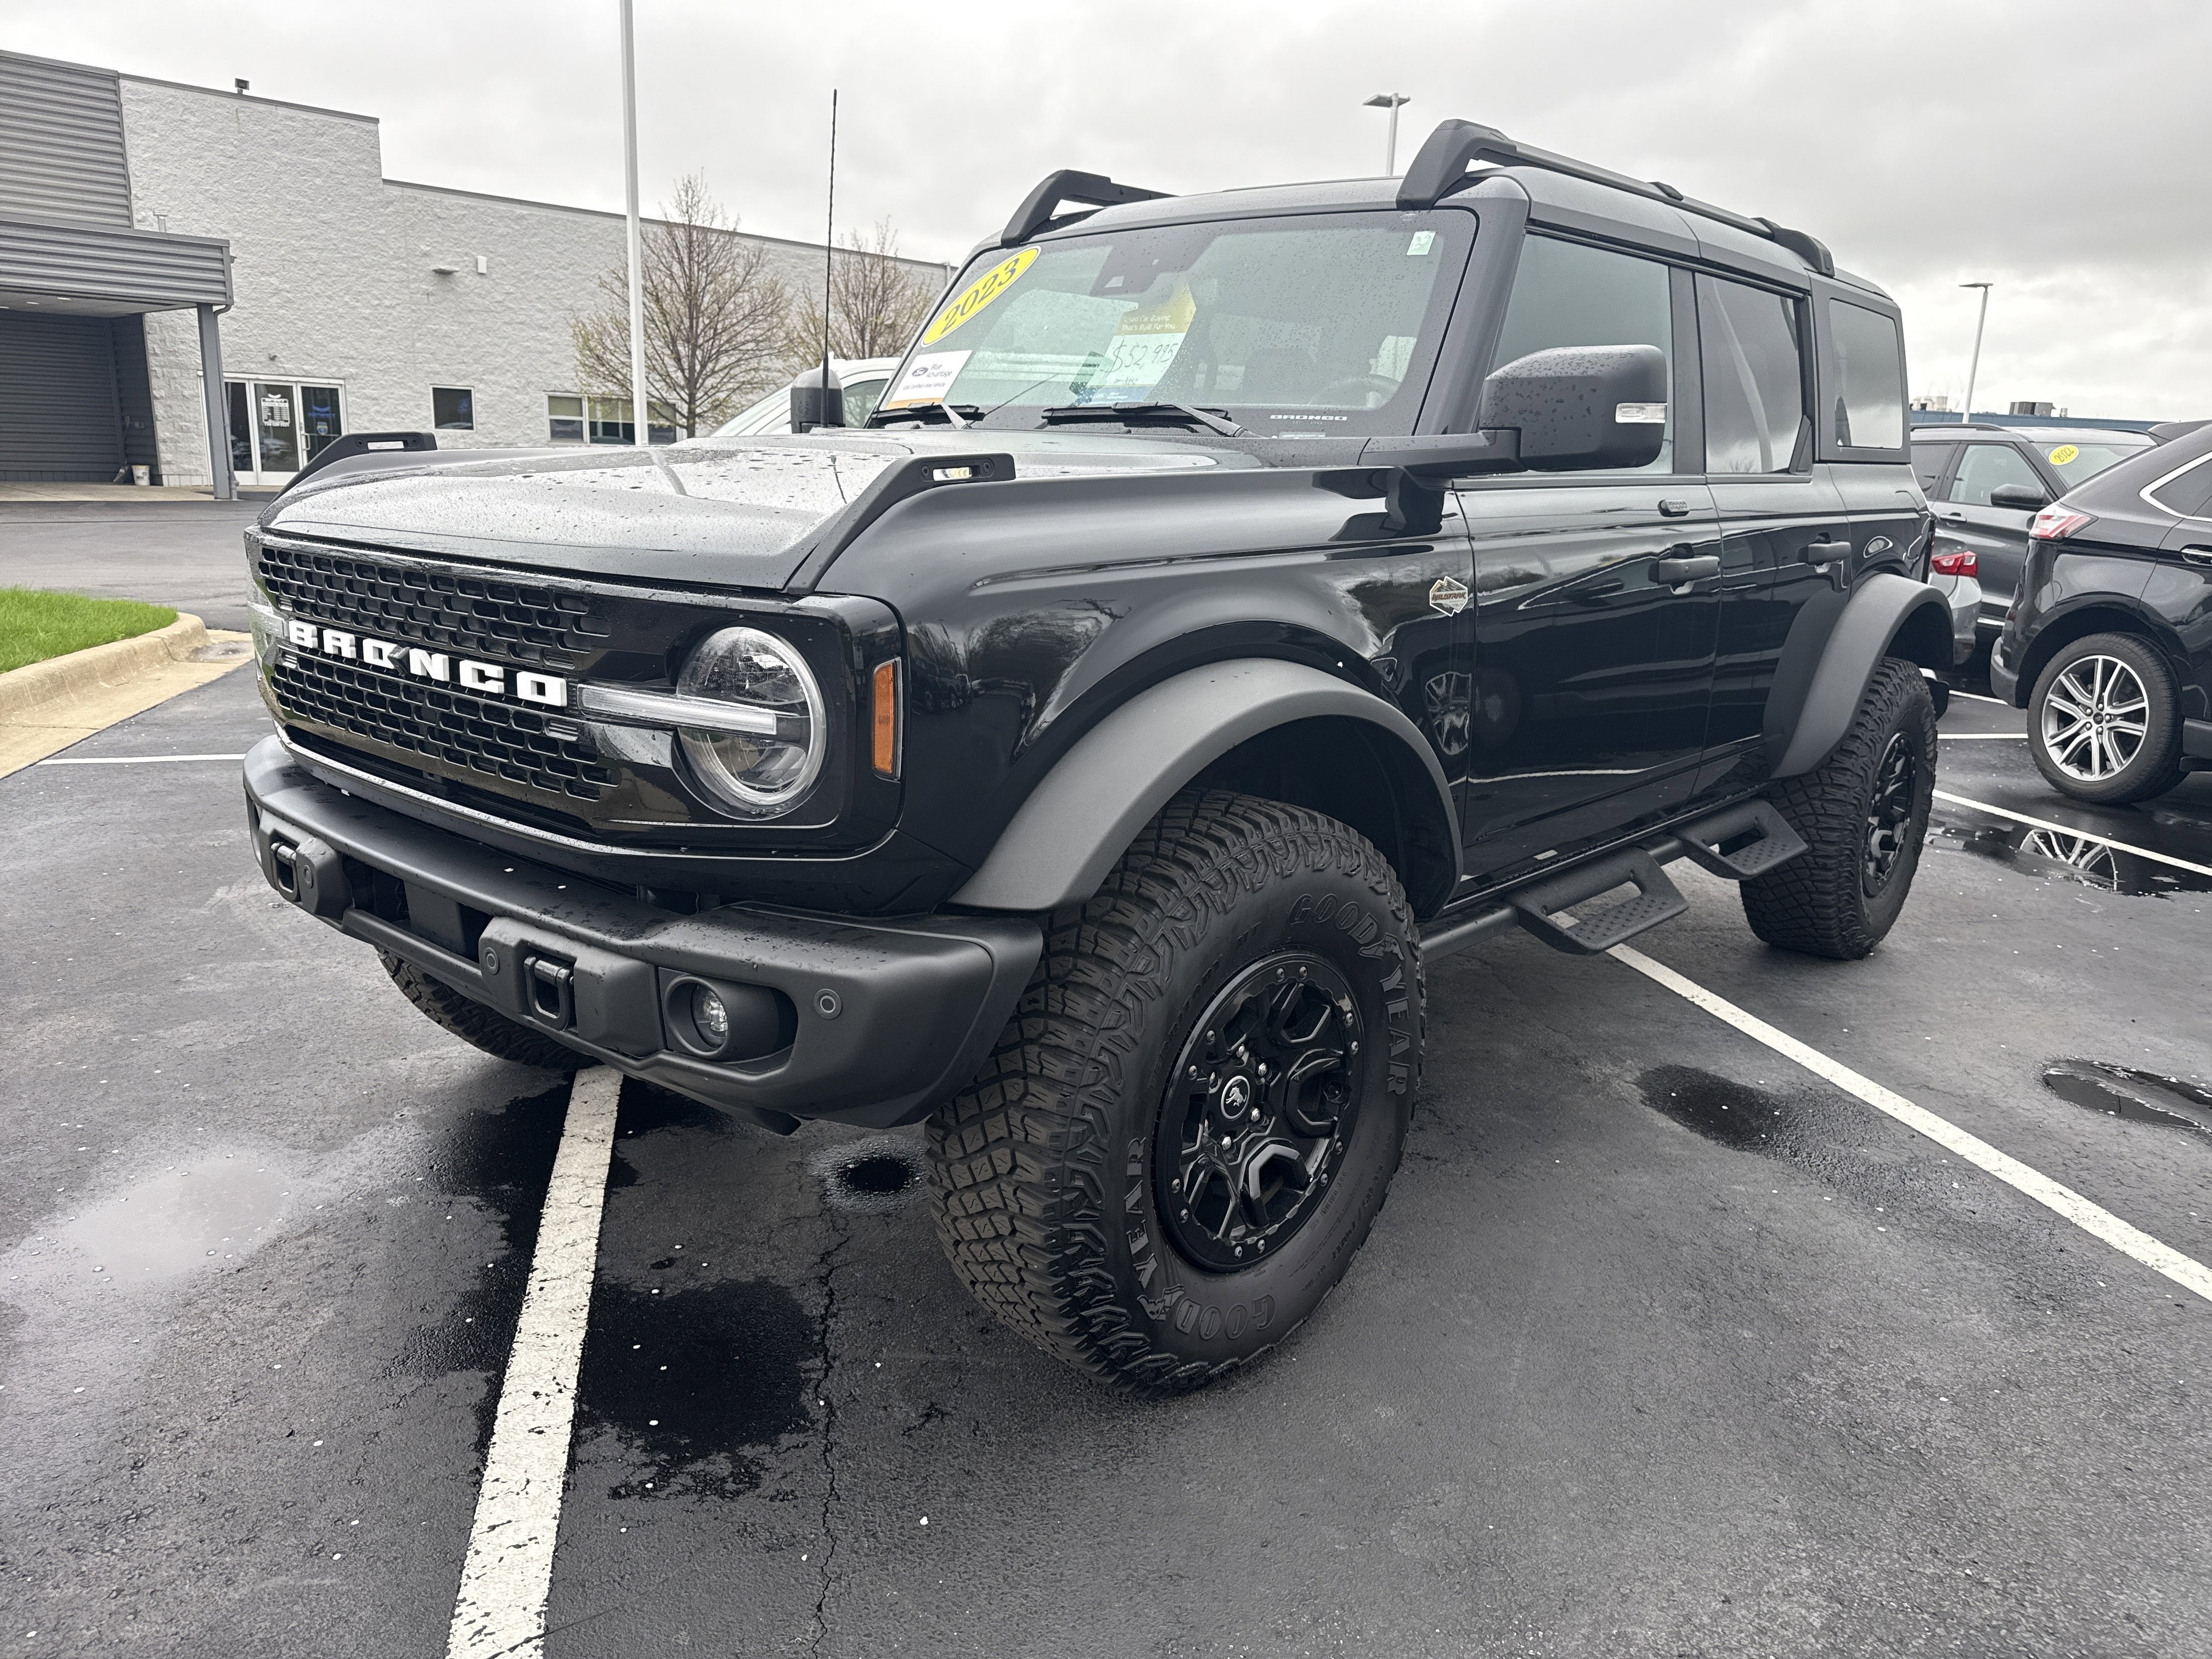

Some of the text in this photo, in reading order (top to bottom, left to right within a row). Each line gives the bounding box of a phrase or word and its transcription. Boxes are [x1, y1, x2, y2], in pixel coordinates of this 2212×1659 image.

[940, 258, 1020, 336] 2023
[2053, 447, 2075, 462] 2022
[1431, 592, 1466, 602] WILDTRAK
[289, 620, 567, 707] BRONCO
[1287, 893, 1412, 1095] GOODYEAR
[1124, 1136, 1277, 1340] GOODYEAR
